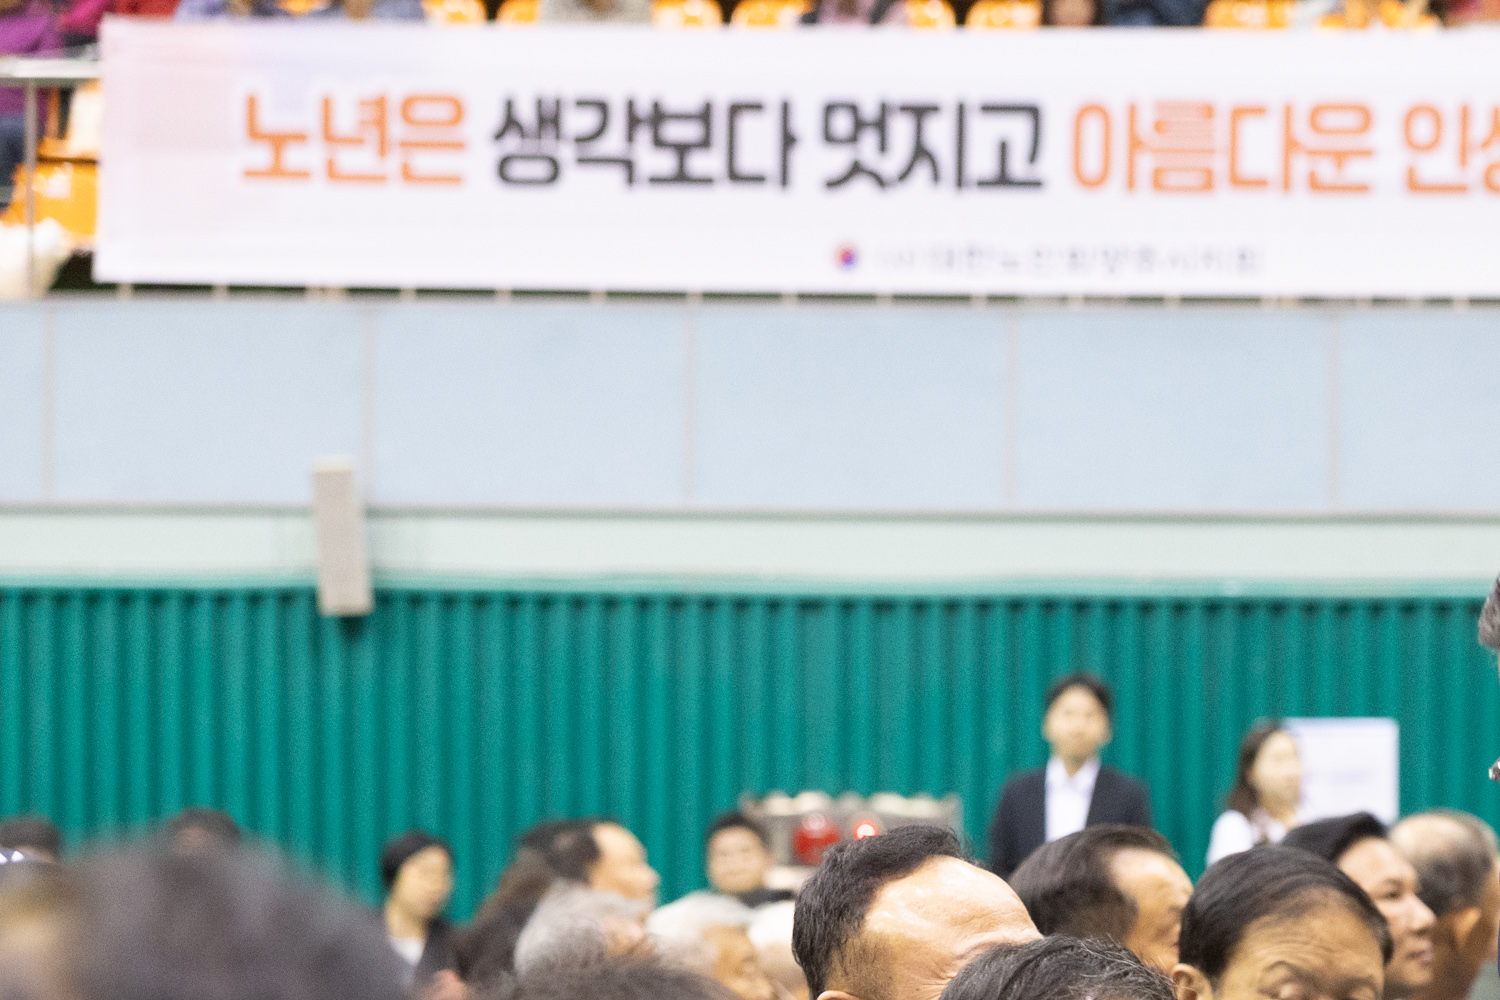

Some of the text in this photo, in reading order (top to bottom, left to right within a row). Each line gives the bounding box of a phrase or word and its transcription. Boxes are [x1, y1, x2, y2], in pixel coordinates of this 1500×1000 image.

[241, 92, 467, 186] 노년은
[489, 94, 801, 191] 생각보다
[818, 97, 1046, 193] 멋지고
[1070, 101, 1374, 195] 아름다운
